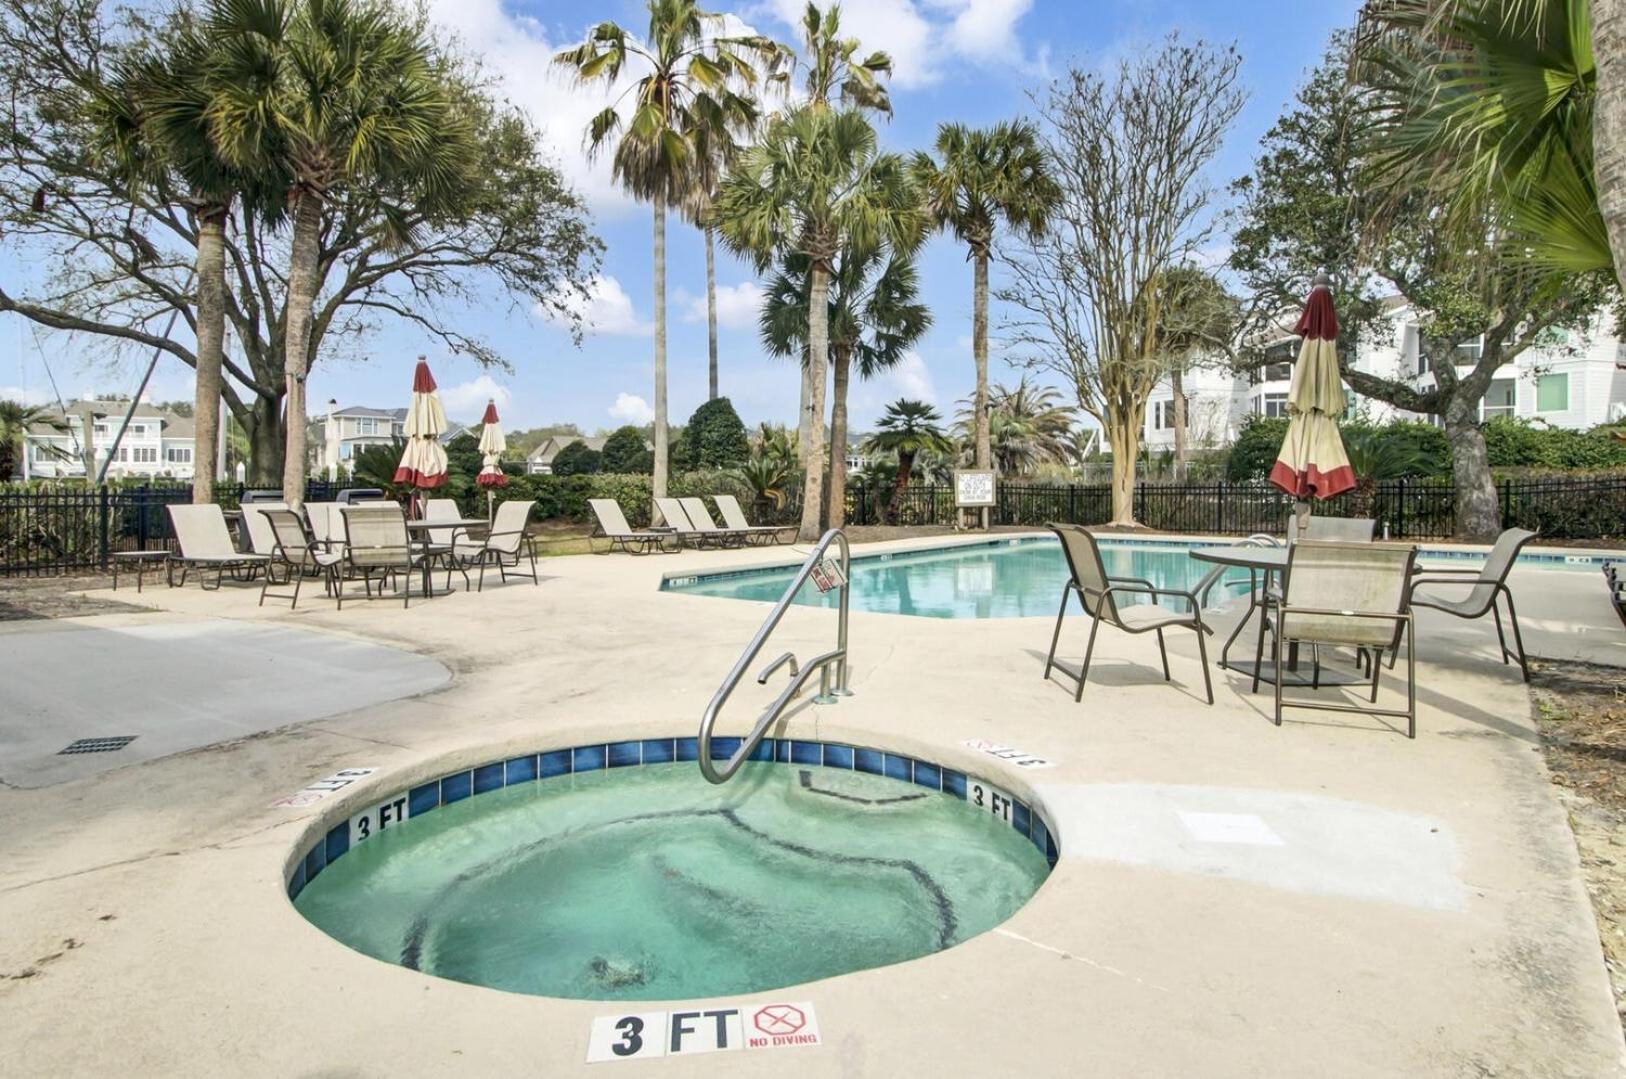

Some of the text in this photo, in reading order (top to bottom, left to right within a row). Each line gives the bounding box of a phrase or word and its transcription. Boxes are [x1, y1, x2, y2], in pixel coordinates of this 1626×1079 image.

[358, 797, 406, 842] 3 FT
[973, 785, 1010, 821] 3 FT
[611, 1009, 739, 1057] 3 FT
[749, 1034, 818, 1048] NO DIVING
